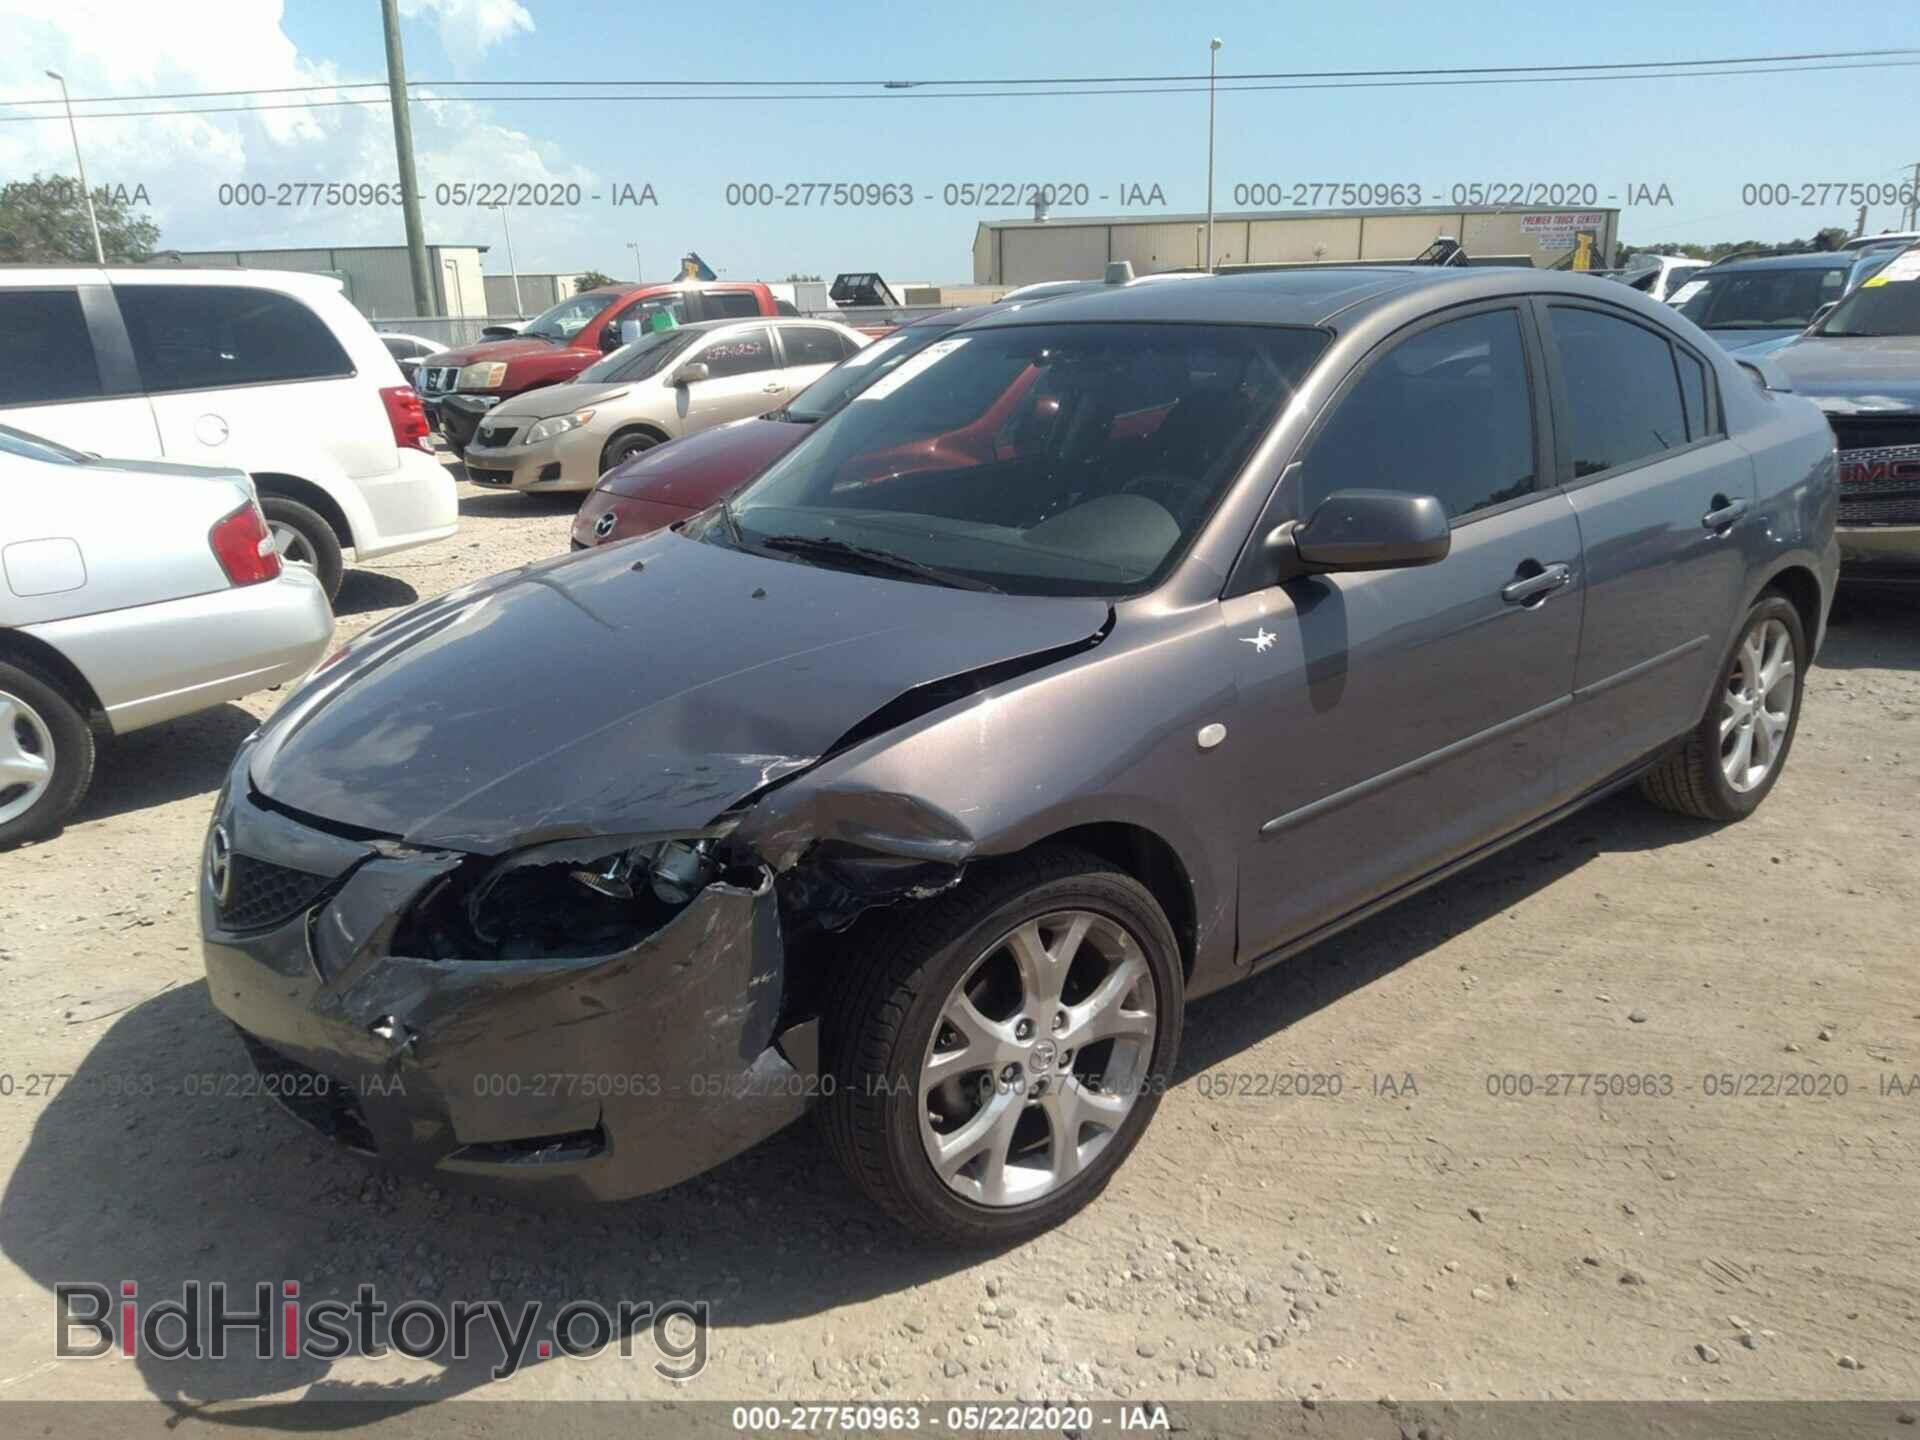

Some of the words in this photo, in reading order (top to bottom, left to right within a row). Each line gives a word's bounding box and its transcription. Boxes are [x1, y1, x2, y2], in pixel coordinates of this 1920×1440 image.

[1522, 216, 1551, 225] PREMIER
[1553, 216, 1574, 224] TRUCK
[1576, 215, 1602, 223] CENTER
